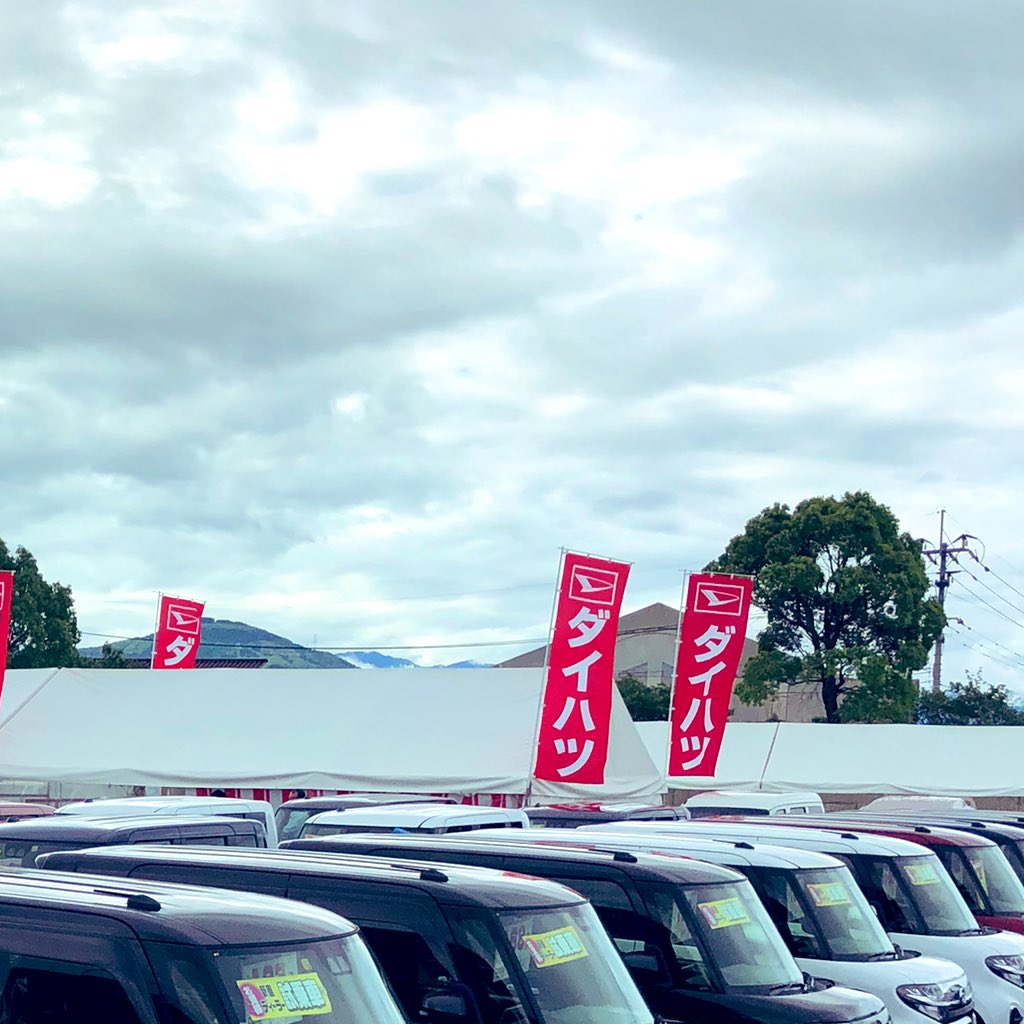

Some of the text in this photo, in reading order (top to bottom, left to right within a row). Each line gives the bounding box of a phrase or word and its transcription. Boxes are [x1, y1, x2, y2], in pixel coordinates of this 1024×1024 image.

[552, 606, 611, 777] ダイハツ
[680, 624, 737, 771] ダイハツ
